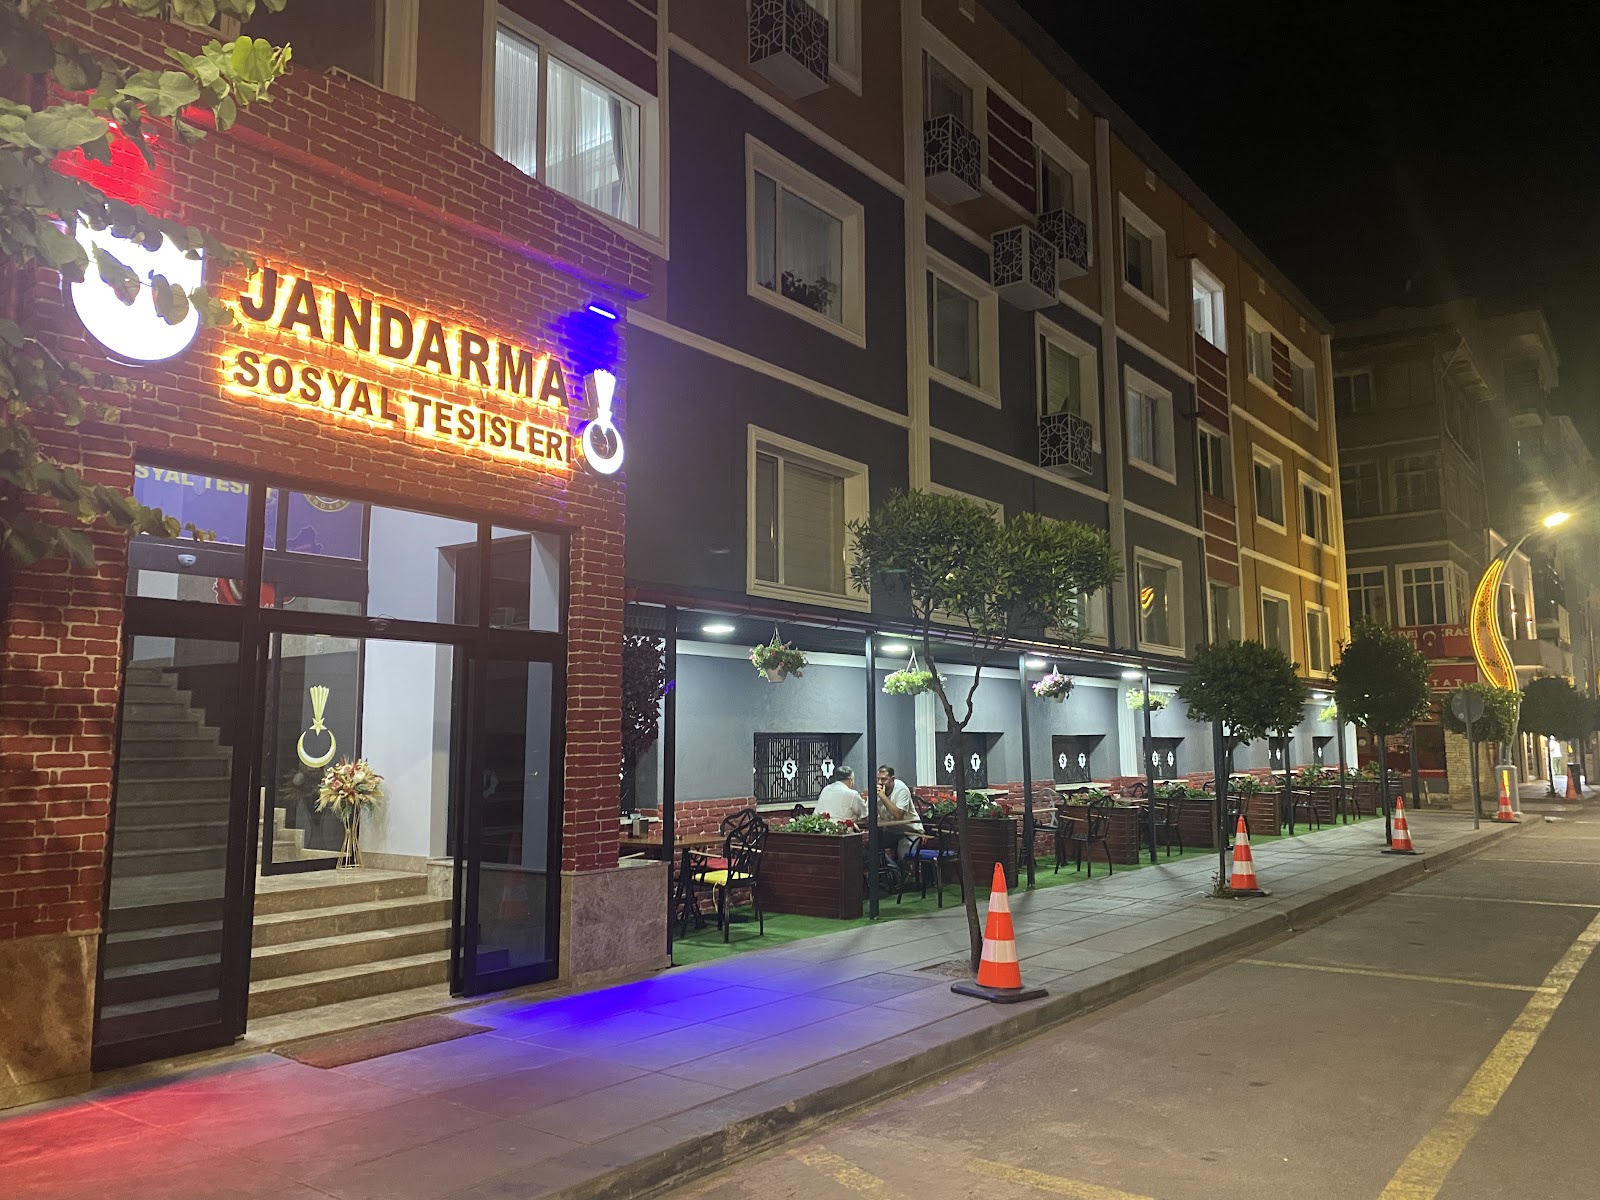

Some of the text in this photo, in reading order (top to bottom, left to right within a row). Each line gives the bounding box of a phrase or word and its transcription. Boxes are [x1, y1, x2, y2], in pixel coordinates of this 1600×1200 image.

[239, 267, 569, 409] JANDARMA
[234, 350, 398, 423] SOSYAL
[786, 761, 831, 775] S T
